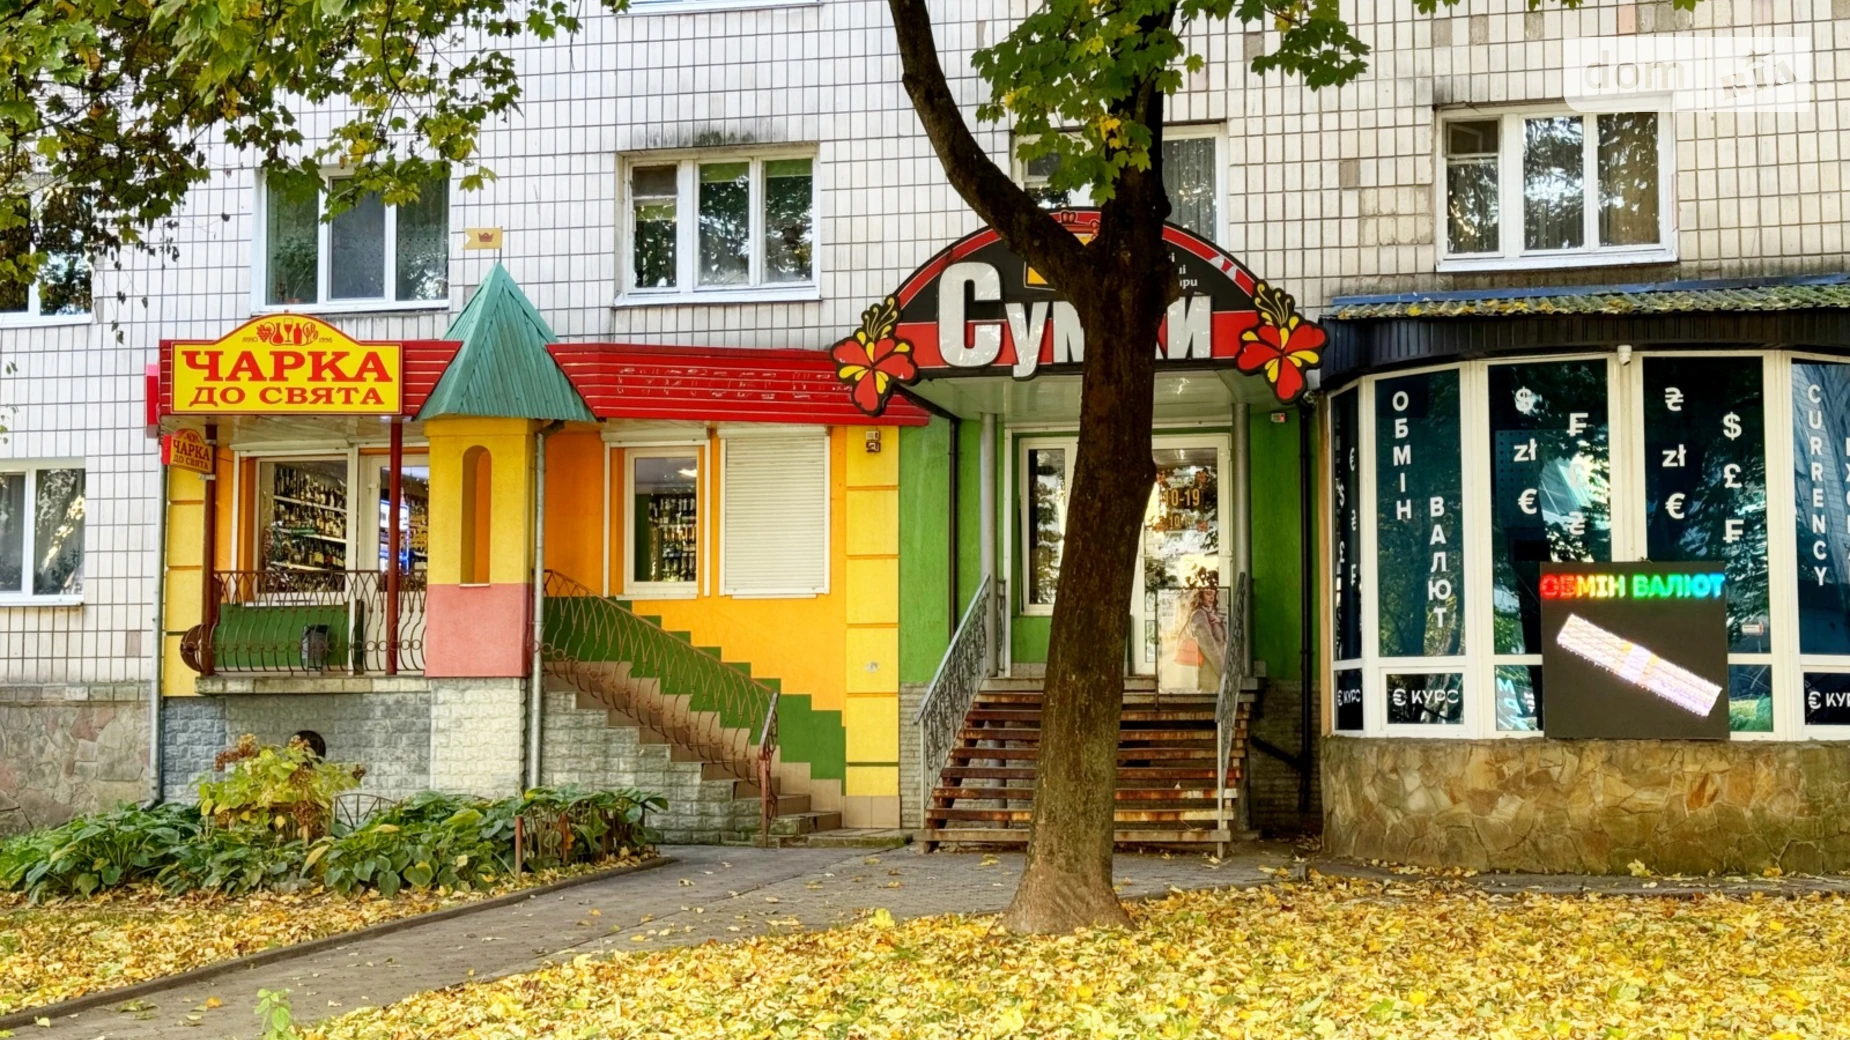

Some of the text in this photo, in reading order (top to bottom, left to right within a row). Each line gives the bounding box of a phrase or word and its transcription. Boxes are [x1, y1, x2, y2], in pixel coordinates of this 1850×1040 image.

[938, 262, 1212, 380] Суи
[181, 350, 393, 382] ЧАРКА
[188, 386, 385, 408] ДО СВЯТА
[1722, 411, 1742, 441] $
[172, 439, 210, 461] ЧАРКА
[1392, 391, 1413, 520] ОБМІН
[1807, 384, 1827, 586] CURRENCY
[1428, 496, 1452, 628] ВАЛЮТ
[1541, 574, 1725, 598] ОБМІН ВАЛЮТ
[1411, 690, 1459, 704] КУРС
